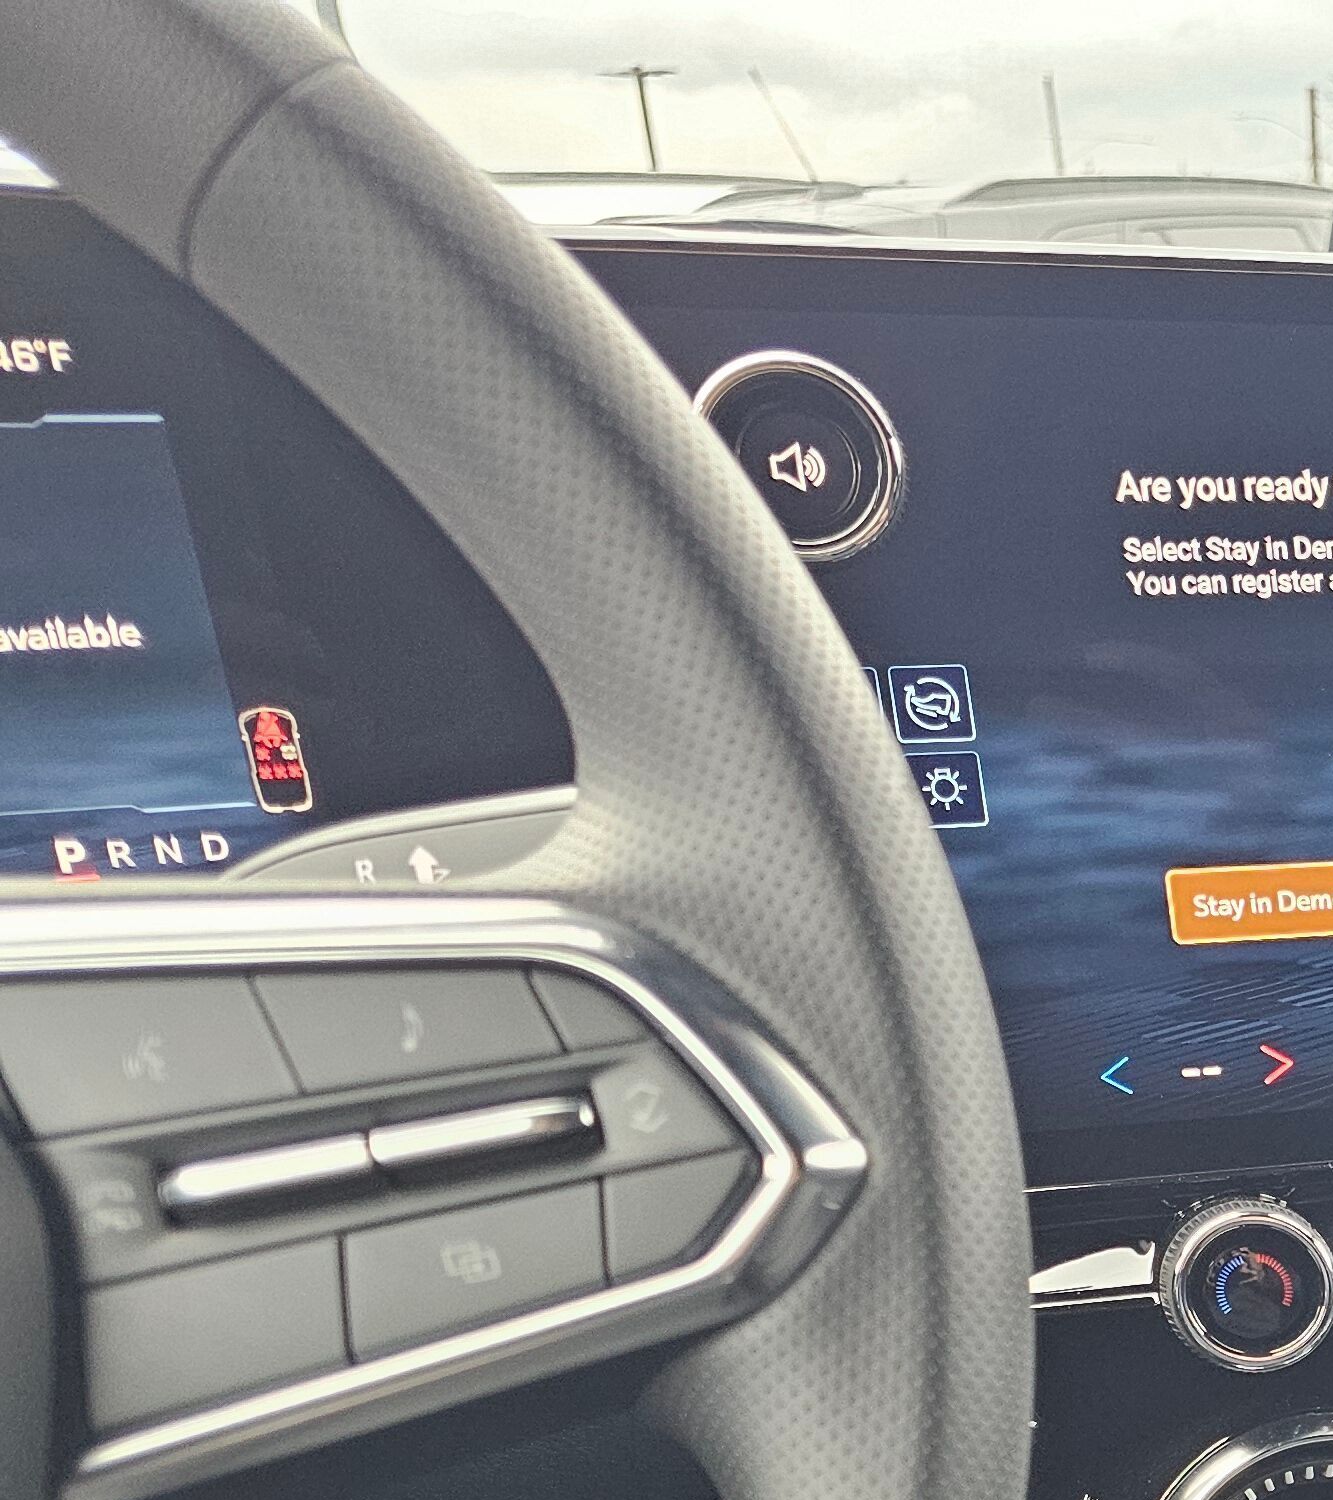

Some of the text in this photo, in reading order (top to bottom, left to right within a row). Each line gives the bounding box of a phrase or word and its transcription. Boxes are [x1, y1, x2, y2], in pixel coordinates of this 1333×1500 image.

[1115, 469, 1172, 503] Are
[1176, 476, 1237, 509] you
[1243, 468, 1328, 508] ready
[1123, 536, 1202, 563] Select
[1205, 536, 1260, 567] Stay
[1264, 536, 1288, 560] in
[1126, 571, 1176, 596] You
[1182, 574, 1227, 595] can
[1232, 569, 1324, 599] register
[0, 613, 143, 651] available
[54, 832, 230, 874] P R N D
[355, 858, 377, 884] R
[1192, 893, 1245, 921] Stay
[1250, 892, 1272, 914] in
